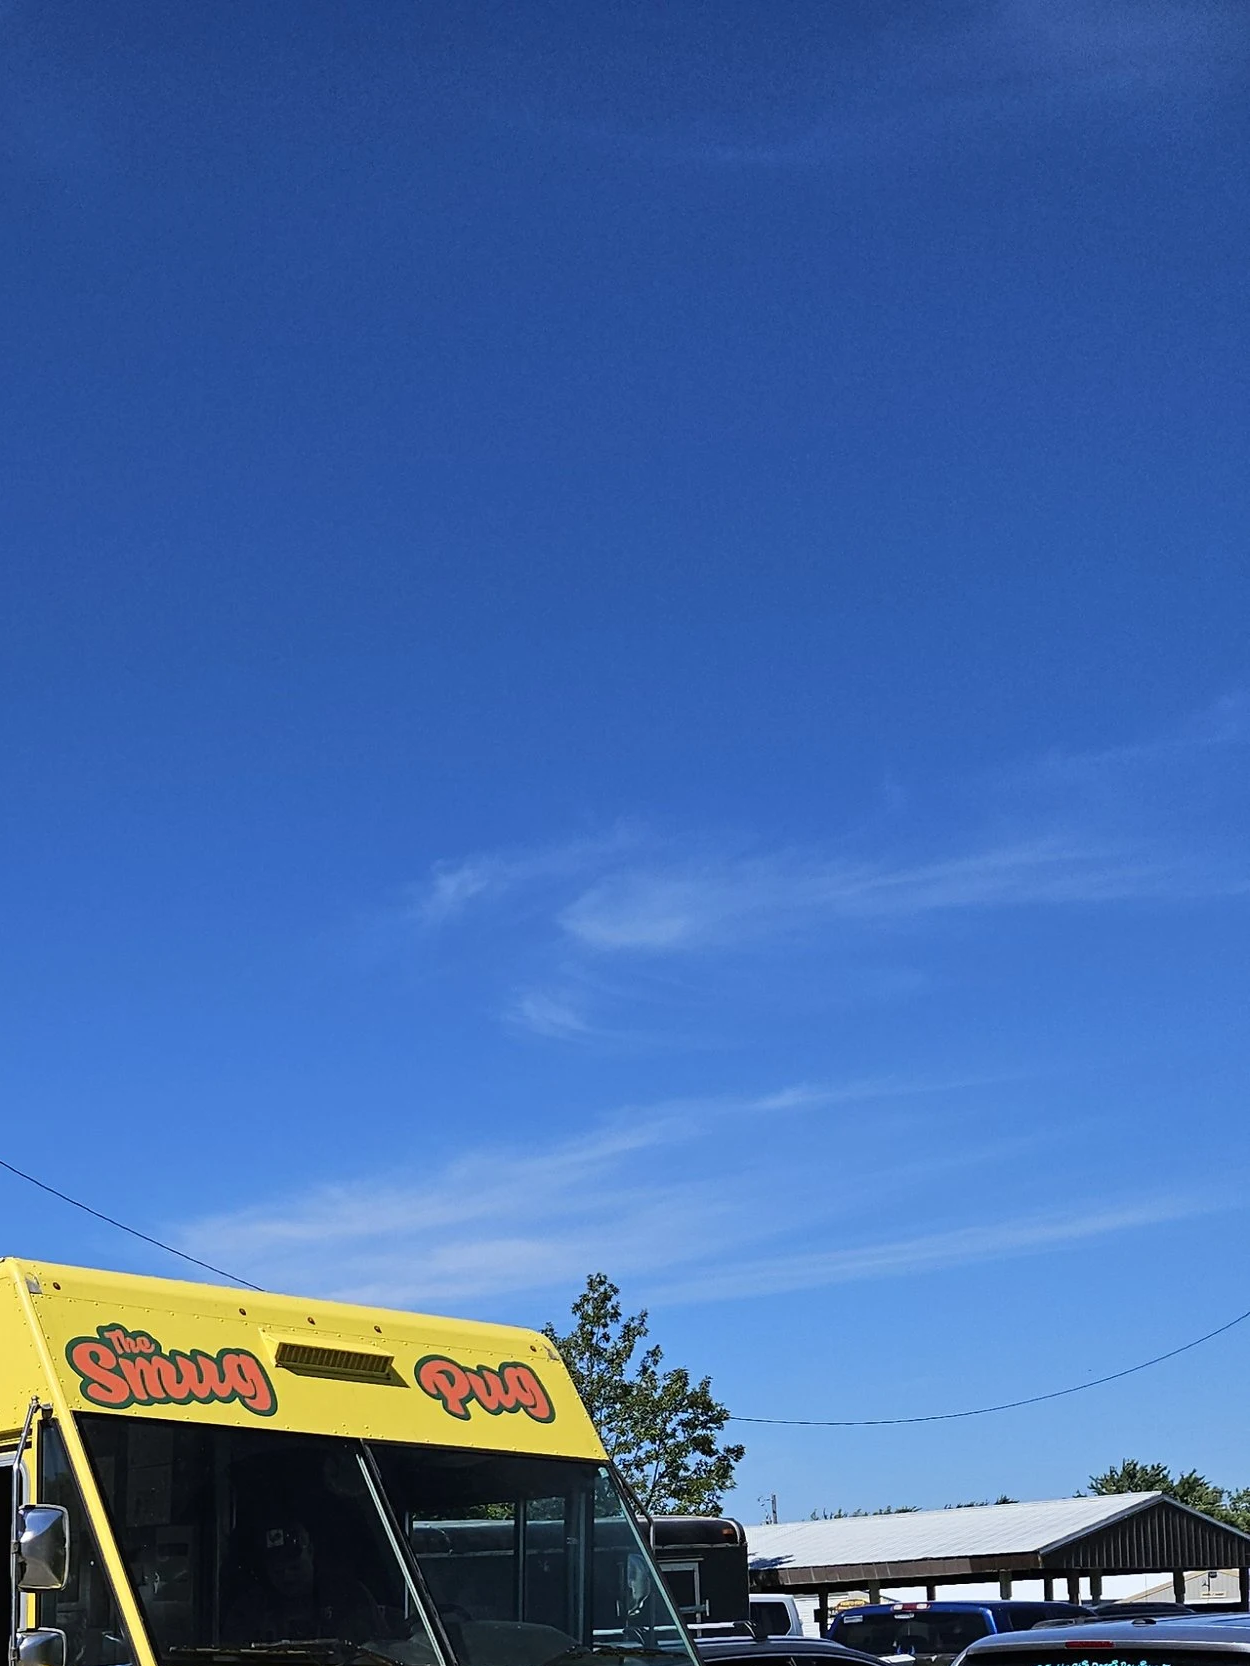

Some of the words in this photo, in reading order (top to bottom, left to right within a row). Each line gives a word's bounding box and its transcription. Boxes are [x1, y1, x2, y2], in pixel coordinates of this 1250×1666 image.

[103, 1328, 156, 1355] The
[69, 1338, 276, 1414] Smug
[417, 1357, 554, 1420] Pug
